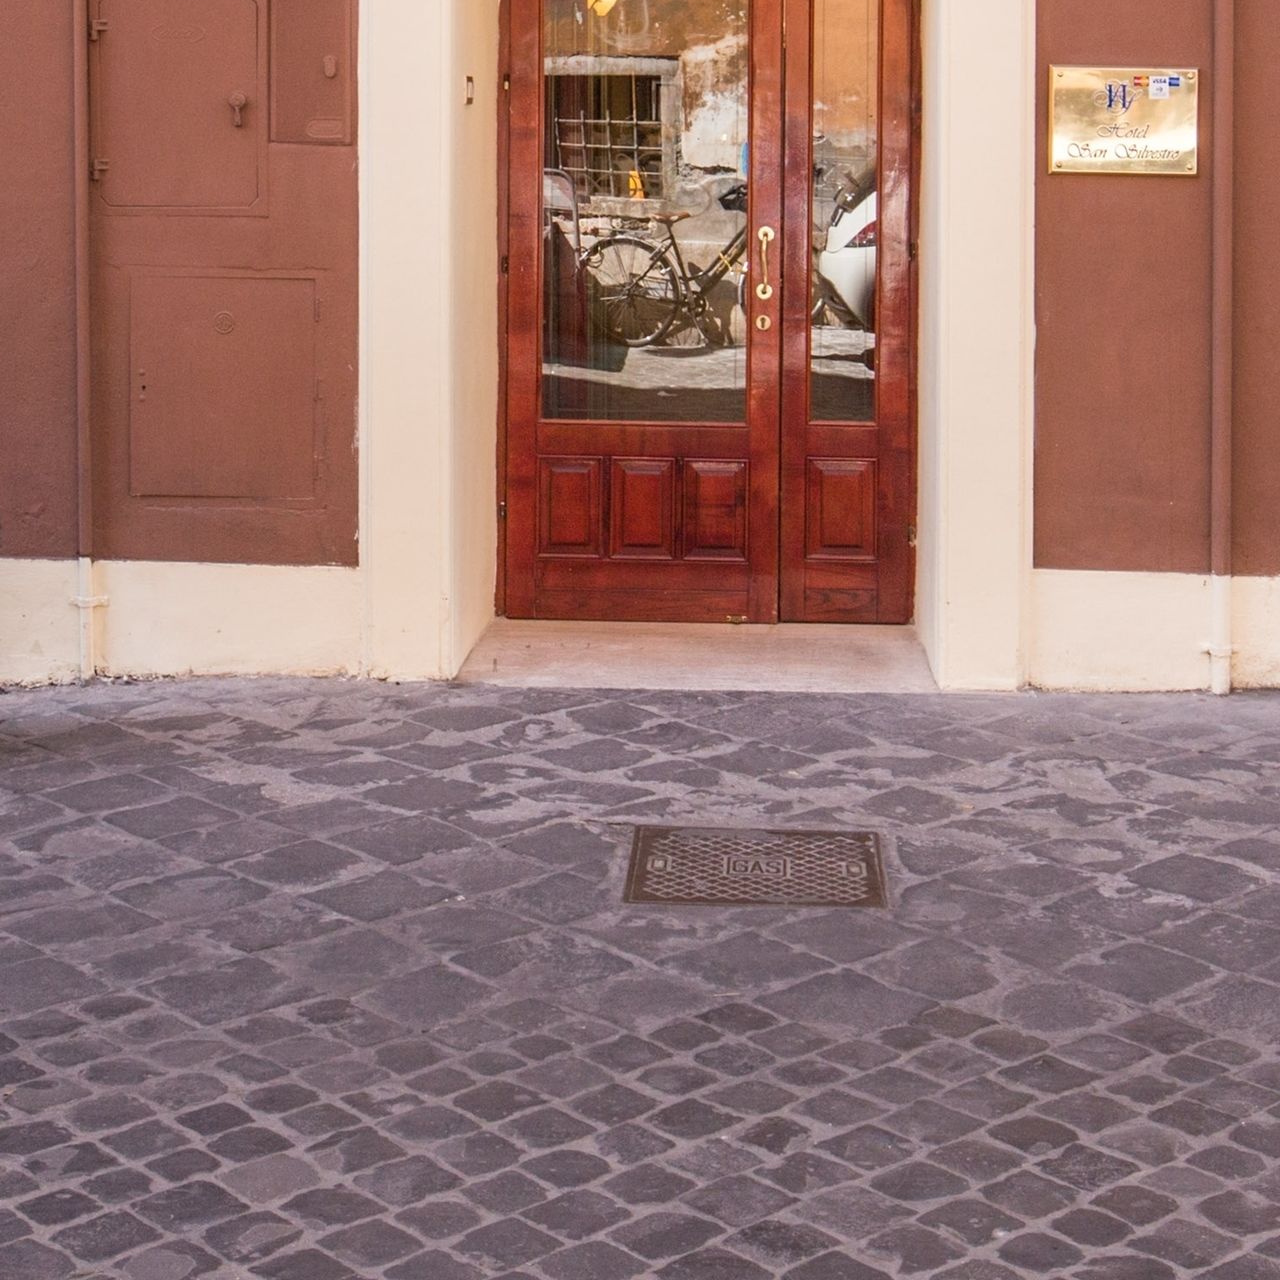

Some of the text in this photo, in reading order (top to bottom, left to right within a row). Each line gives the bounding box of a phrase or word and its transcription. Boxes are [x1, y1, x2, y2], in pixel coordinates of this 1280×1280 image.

[1097, 122, 1150, 139] Hotel
[1067, 142, 1180, 160] San Silvestro
[732, 859, 781, 874] GAS
